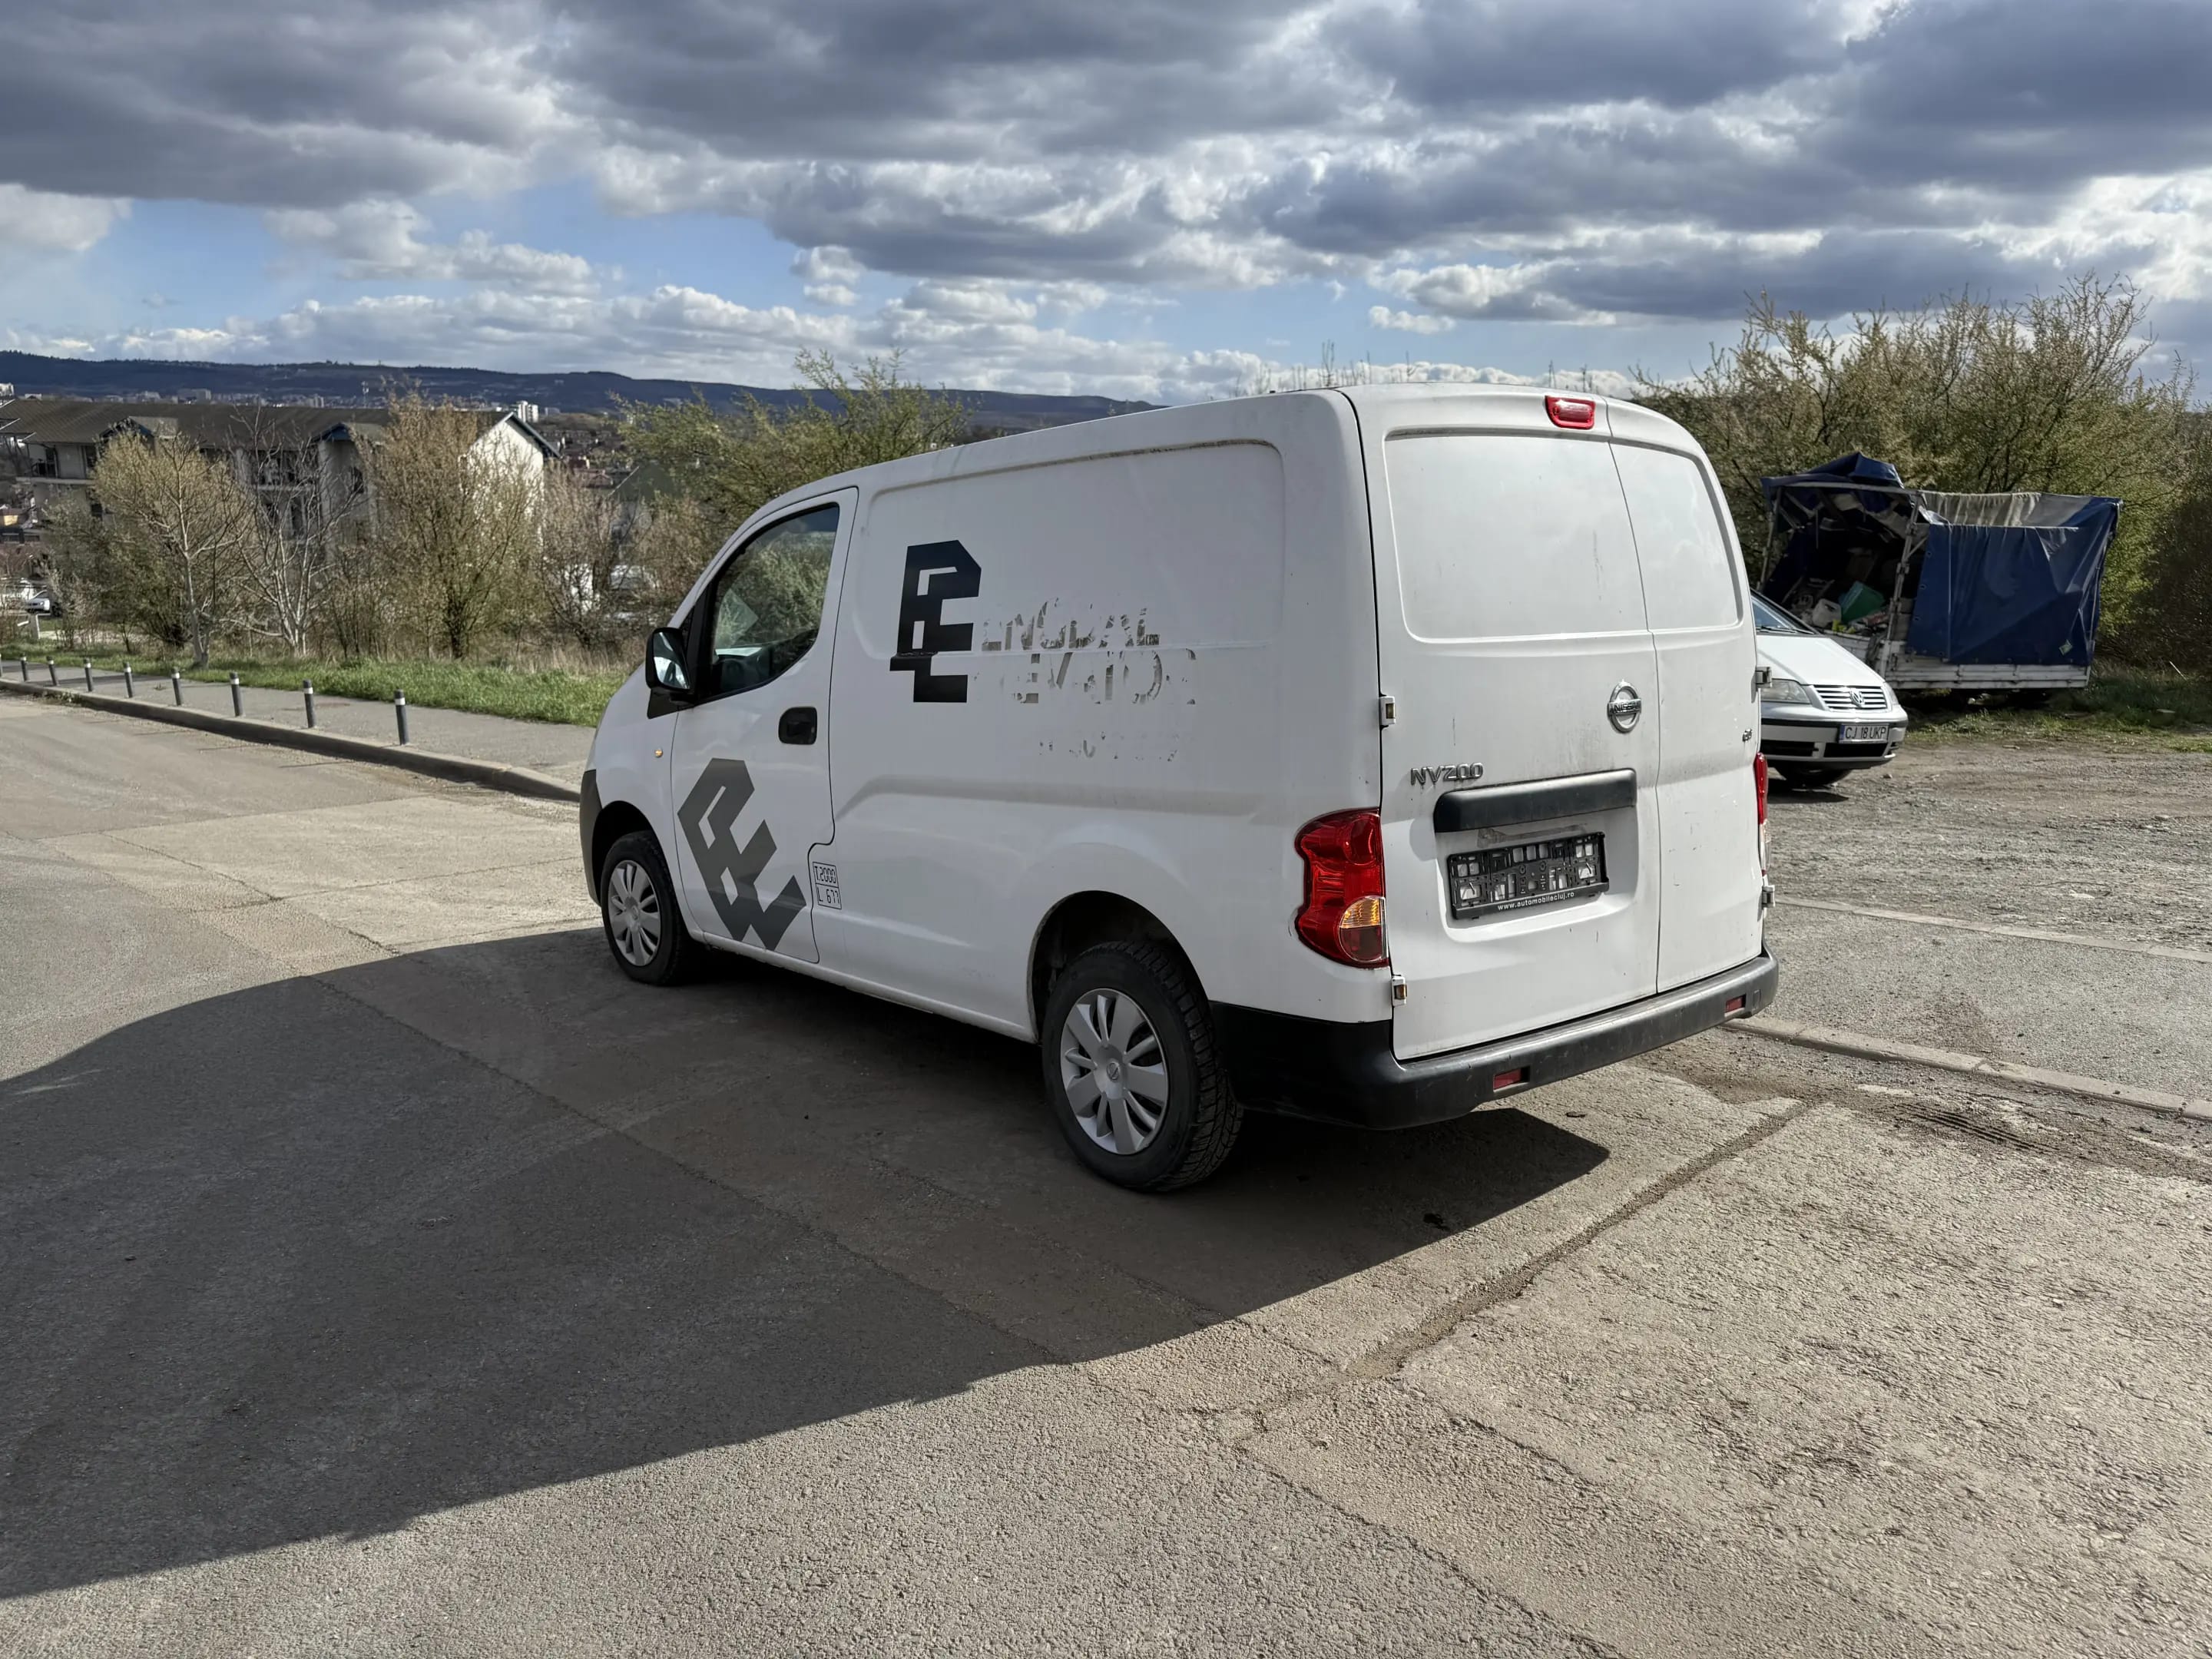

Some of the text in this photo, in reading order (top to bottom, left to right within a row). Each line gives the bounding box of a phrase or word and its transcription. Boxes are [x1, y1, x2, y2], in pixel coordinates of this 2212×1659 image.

[1845, 727, 1886, 739] CJ 18 UKP
[1410, 762, 1483, 786] NV200
[1498, 892, 1575, 910] www.automobilecluj.ro
